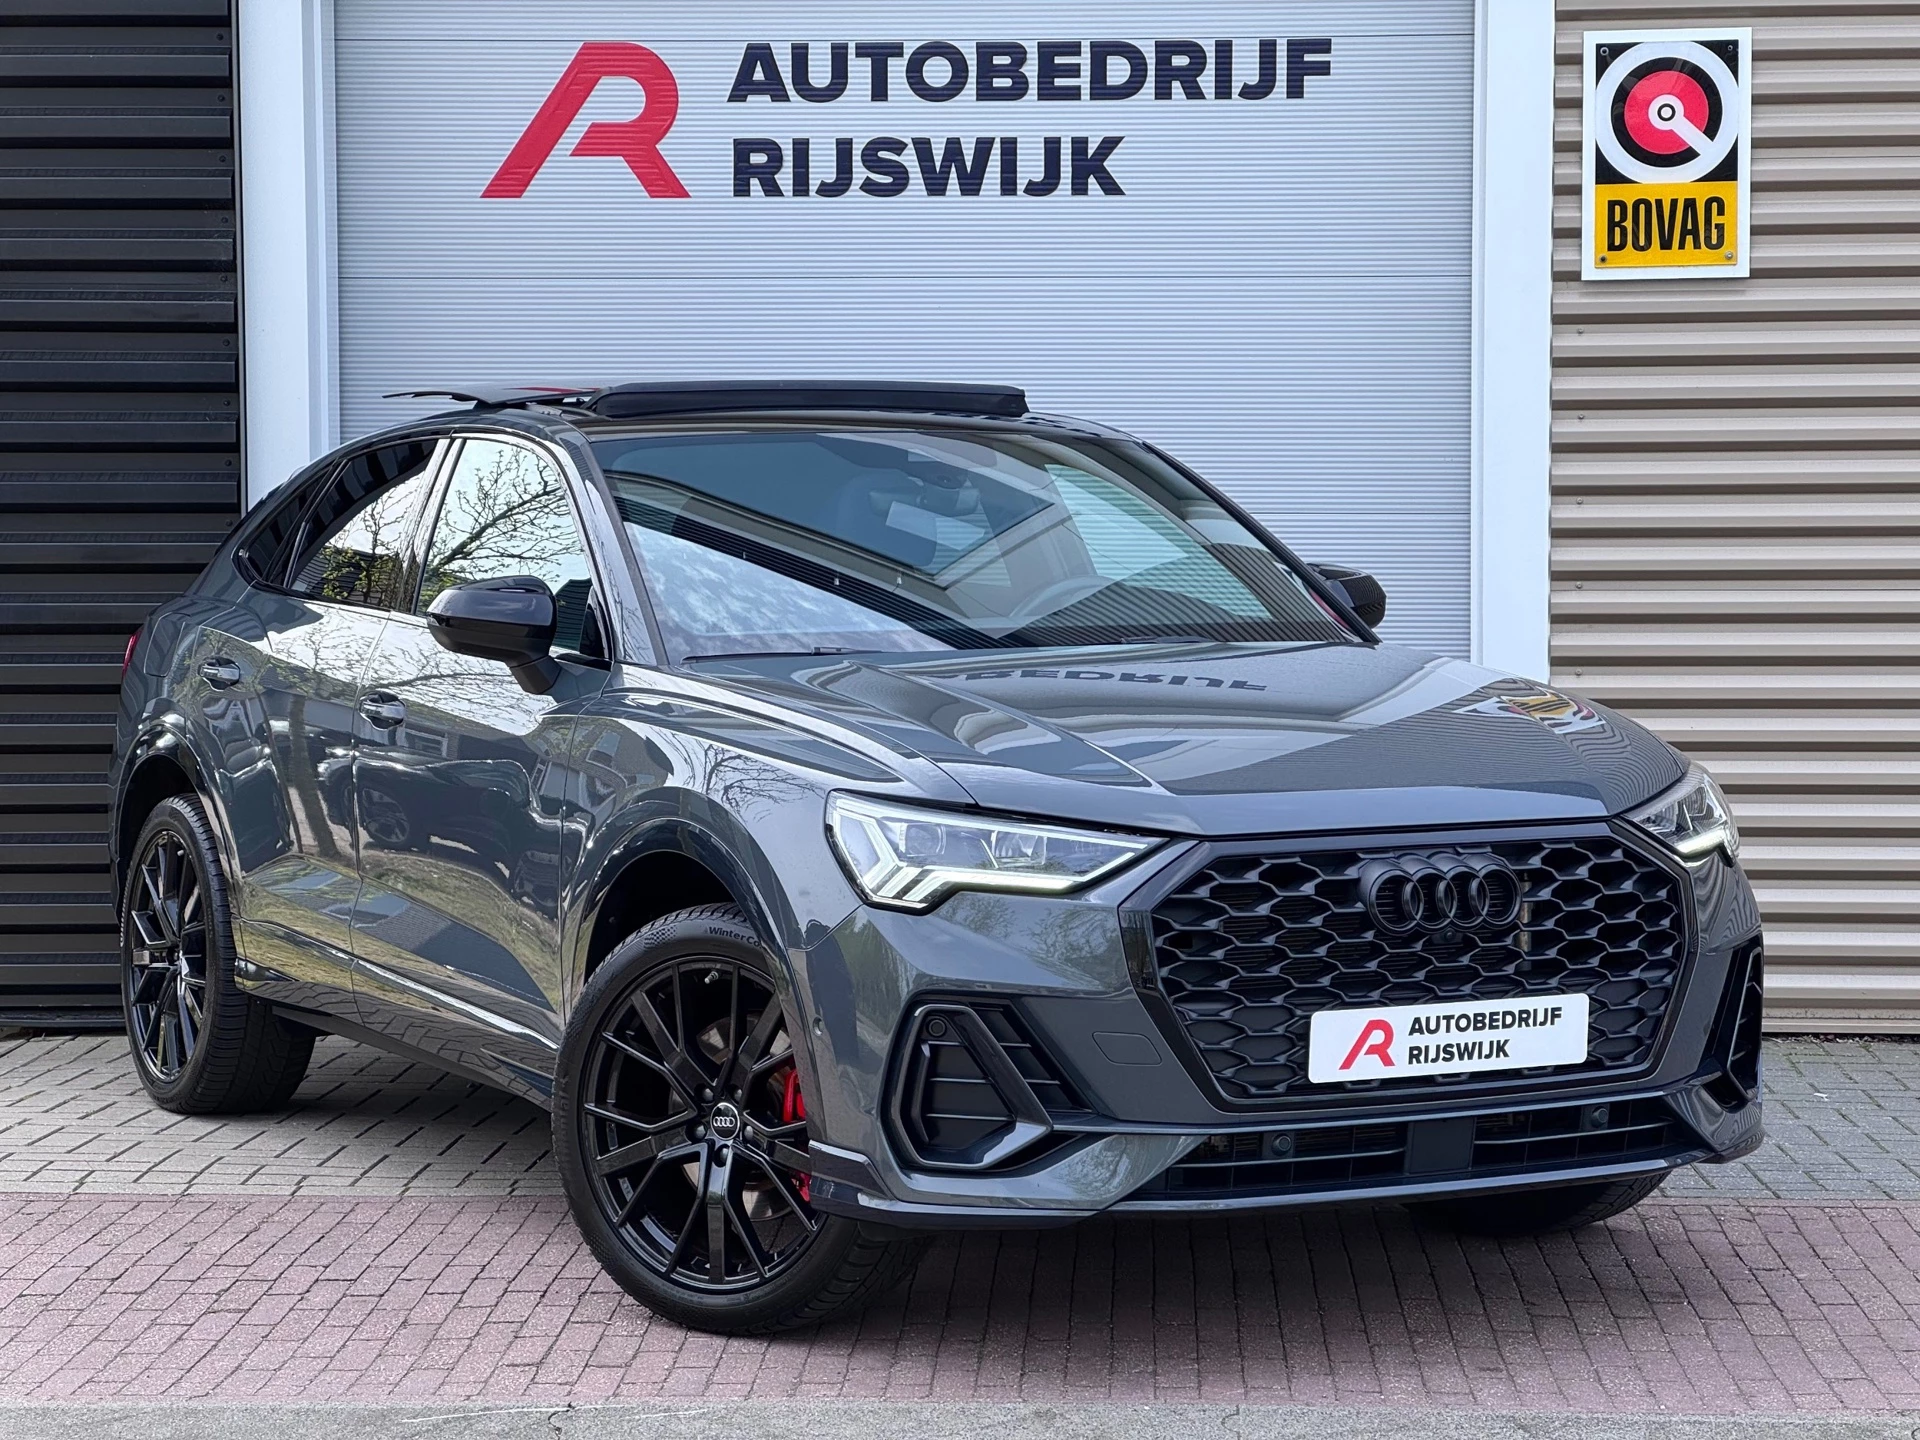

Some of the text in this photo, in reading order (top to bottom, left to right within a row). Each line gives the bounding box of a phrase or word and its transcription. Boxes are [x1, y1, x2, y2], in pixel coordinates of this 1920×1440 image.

[727, 37, 1332, 104] AUTOBEDRIJF
[733, 136, 1126, 198] RIJSWIJK
[1607, 196, 1726, 252] BOVAG
[708, 926, 762, 947] WinterCo
[1407, 1007, 1563, 1036] AUTOBEDRIJF
[1407, 1039, 1511, 1065] RIJSWIJK
